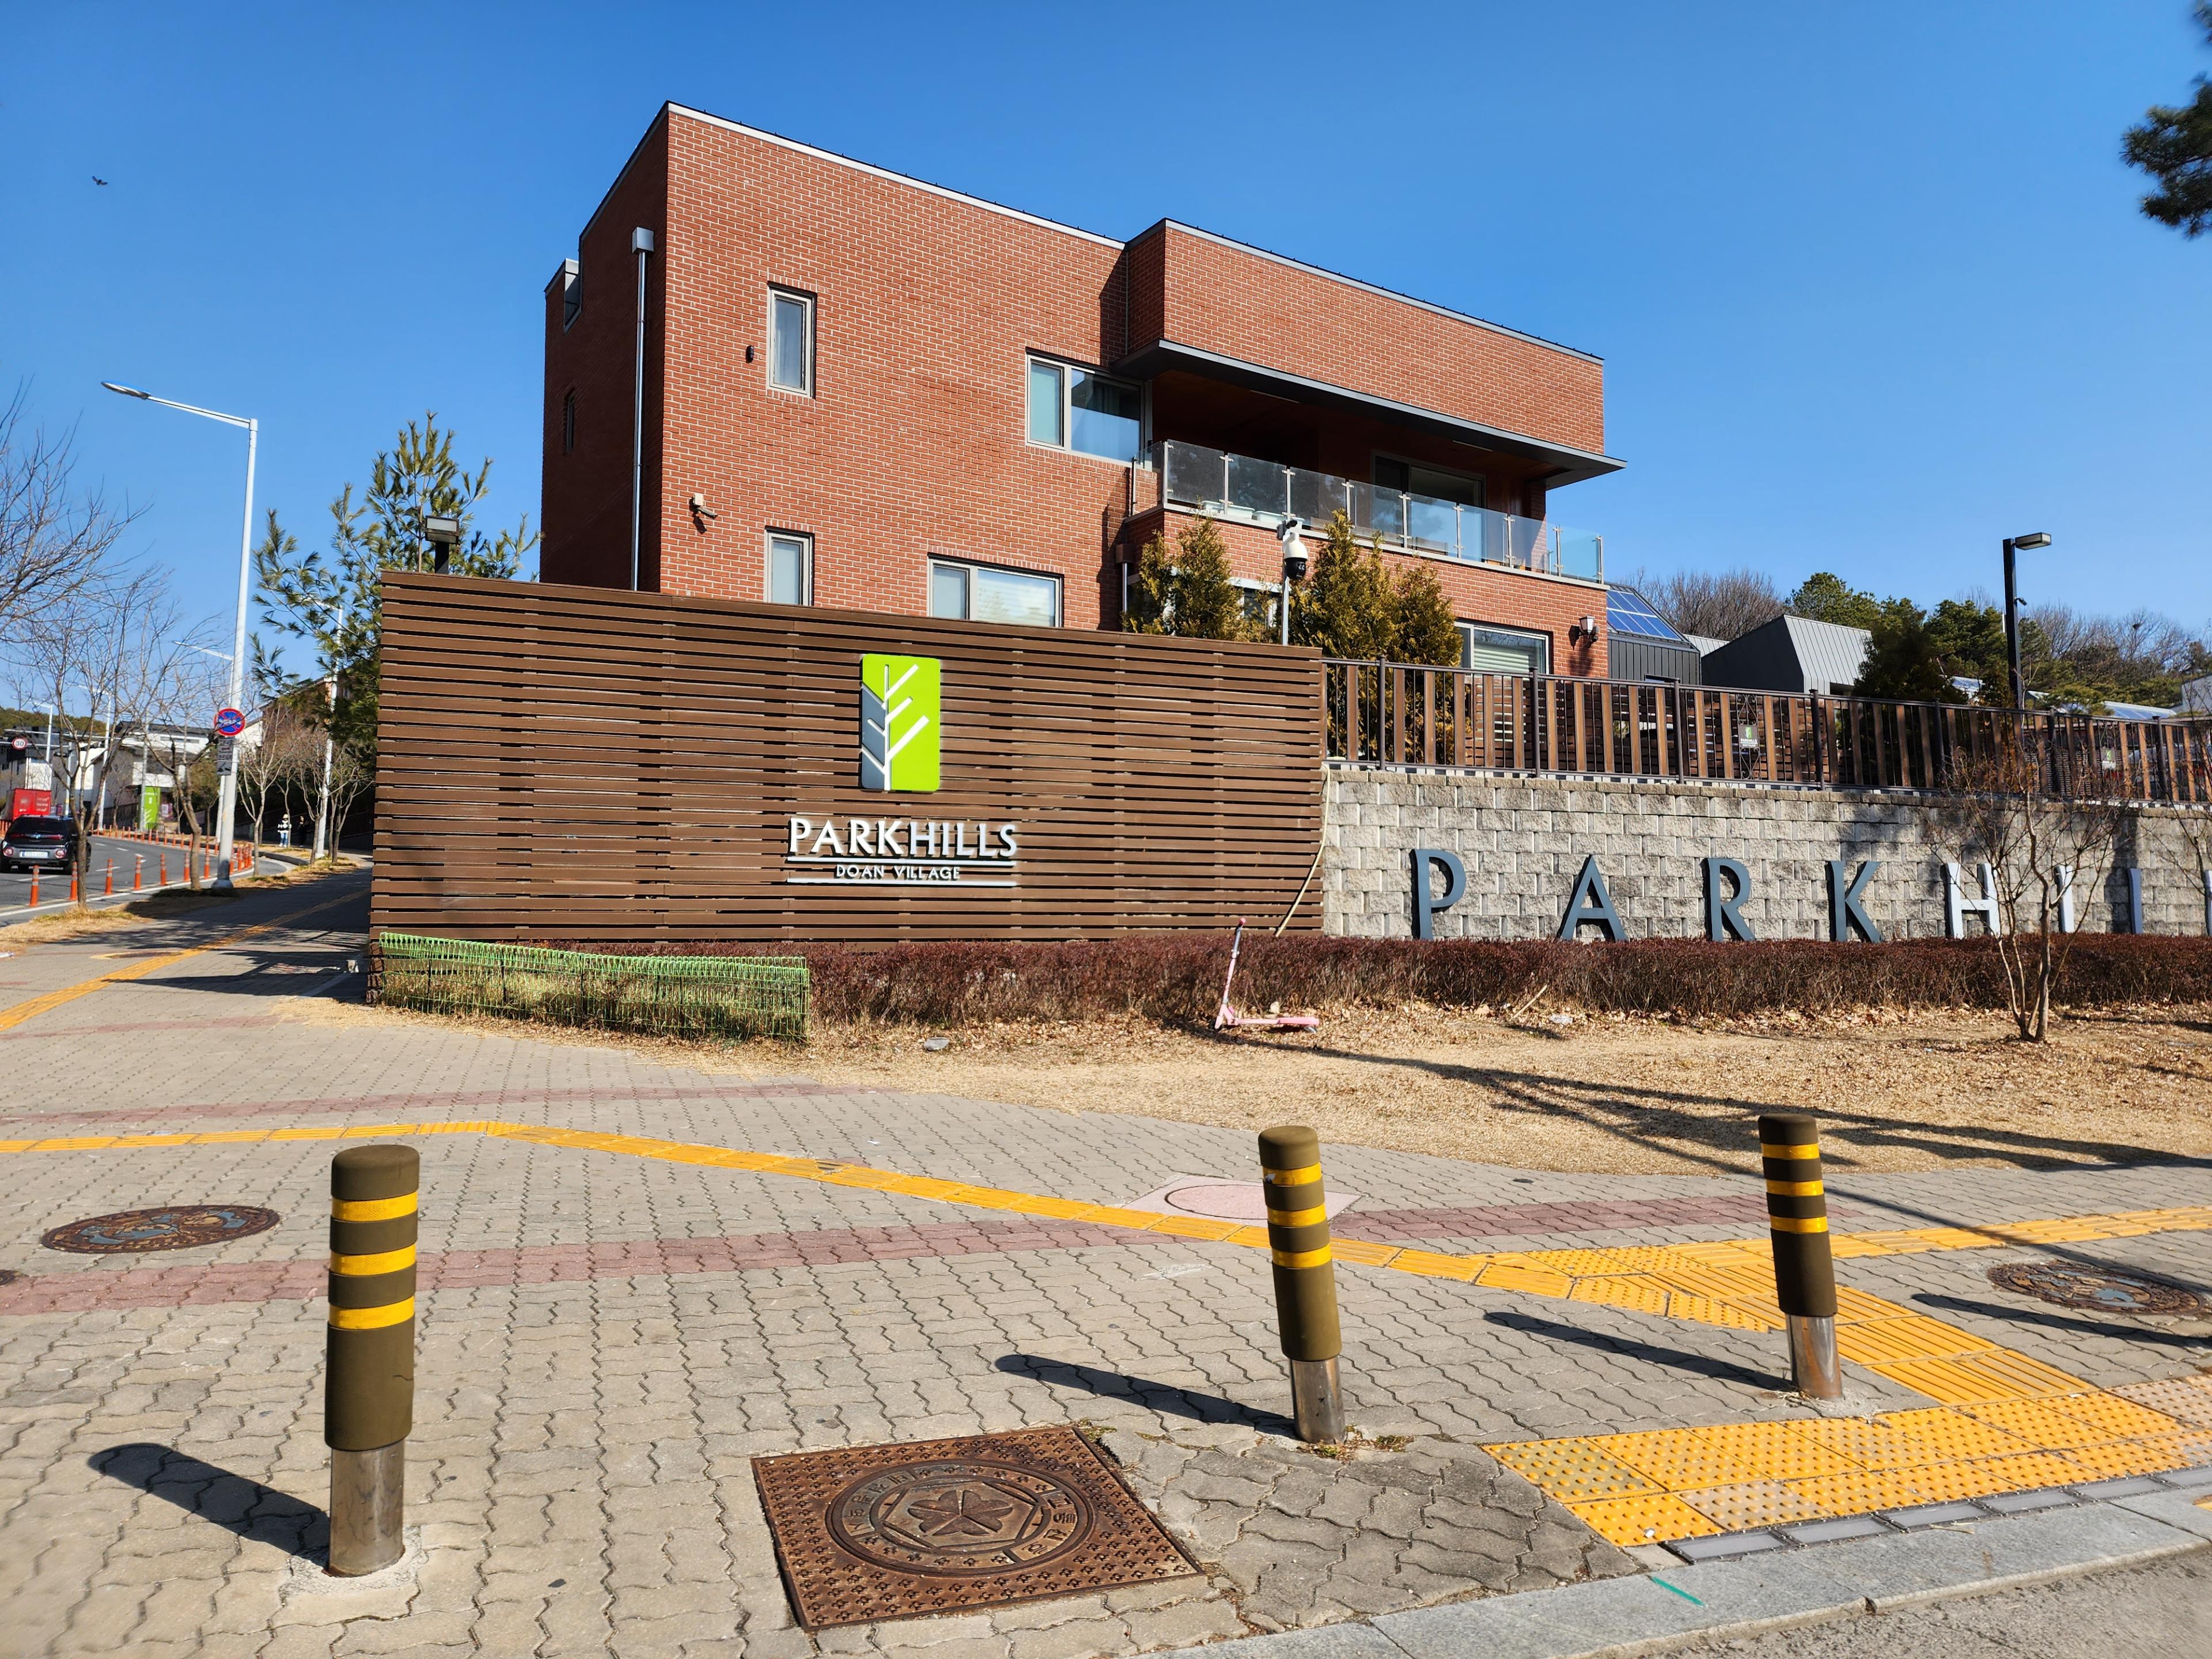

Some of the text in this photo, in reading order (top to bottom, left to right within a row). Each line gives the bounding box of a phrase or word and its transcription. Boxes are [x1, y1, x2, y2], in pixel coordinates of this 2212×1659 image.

[789, 817, 1017, 857] PARKHILLS
[836, 864, 960, 880] DOAN VILLAGE
[845, 1474, 909, 1533] 대전광역시
[1021, 1496, 1075, 1555] 교통신호
